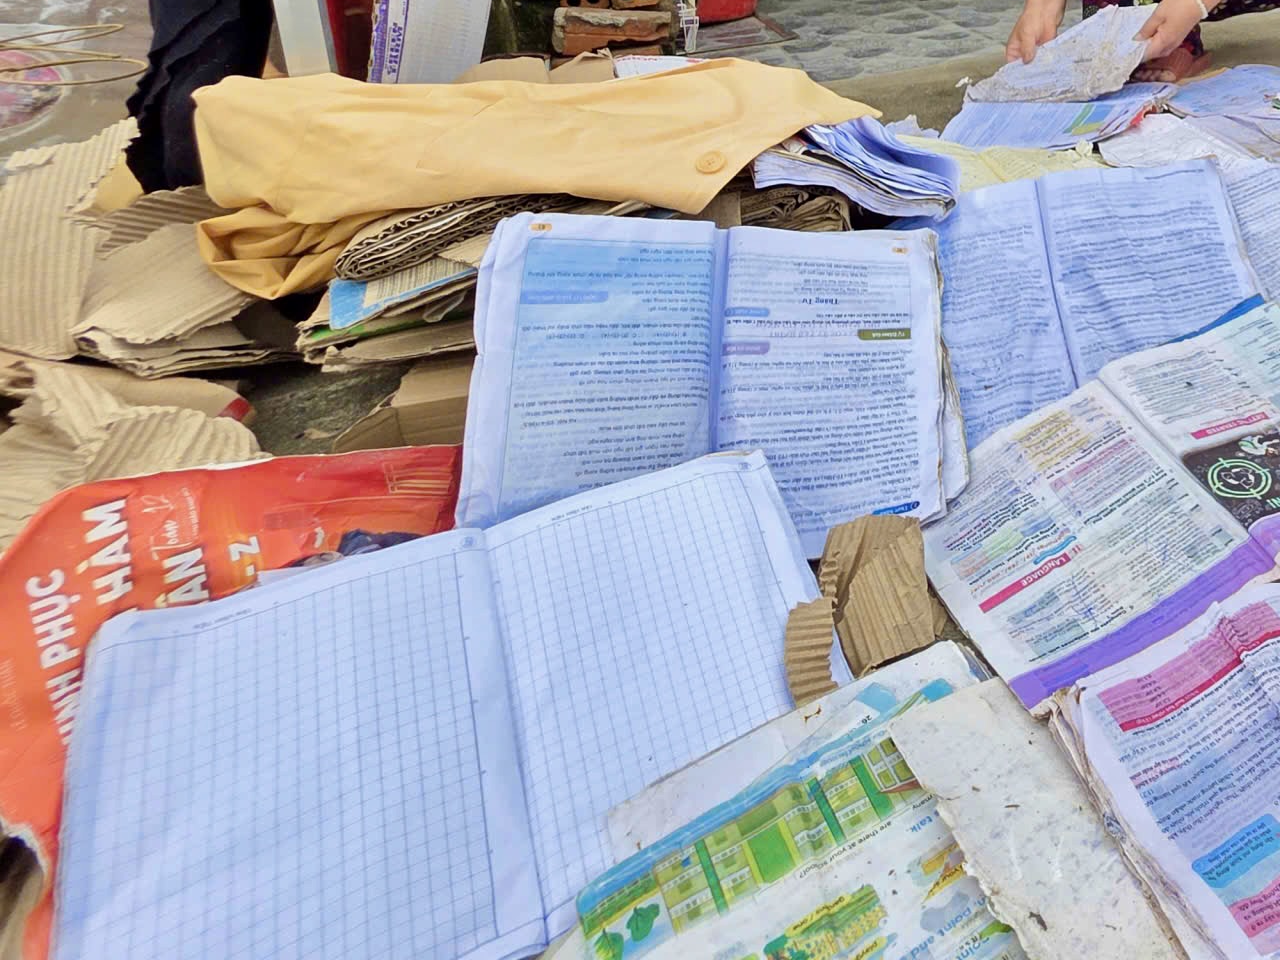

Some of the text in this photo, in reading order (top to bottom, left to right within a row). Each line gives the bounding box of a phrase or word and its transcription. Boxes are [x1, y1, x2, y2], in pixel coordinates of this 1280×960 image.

[76, 497, 136, 606] HÀM
[1019, 555, 1066, 586] LANGUAGE
[25, 569, 81, 669] PHỤC
[860, 713, 872, 725] 26
[827, 794, 933, 863] many are there at your
[934, 904, 974, 940] point
[907, 934, 936, 960] and
